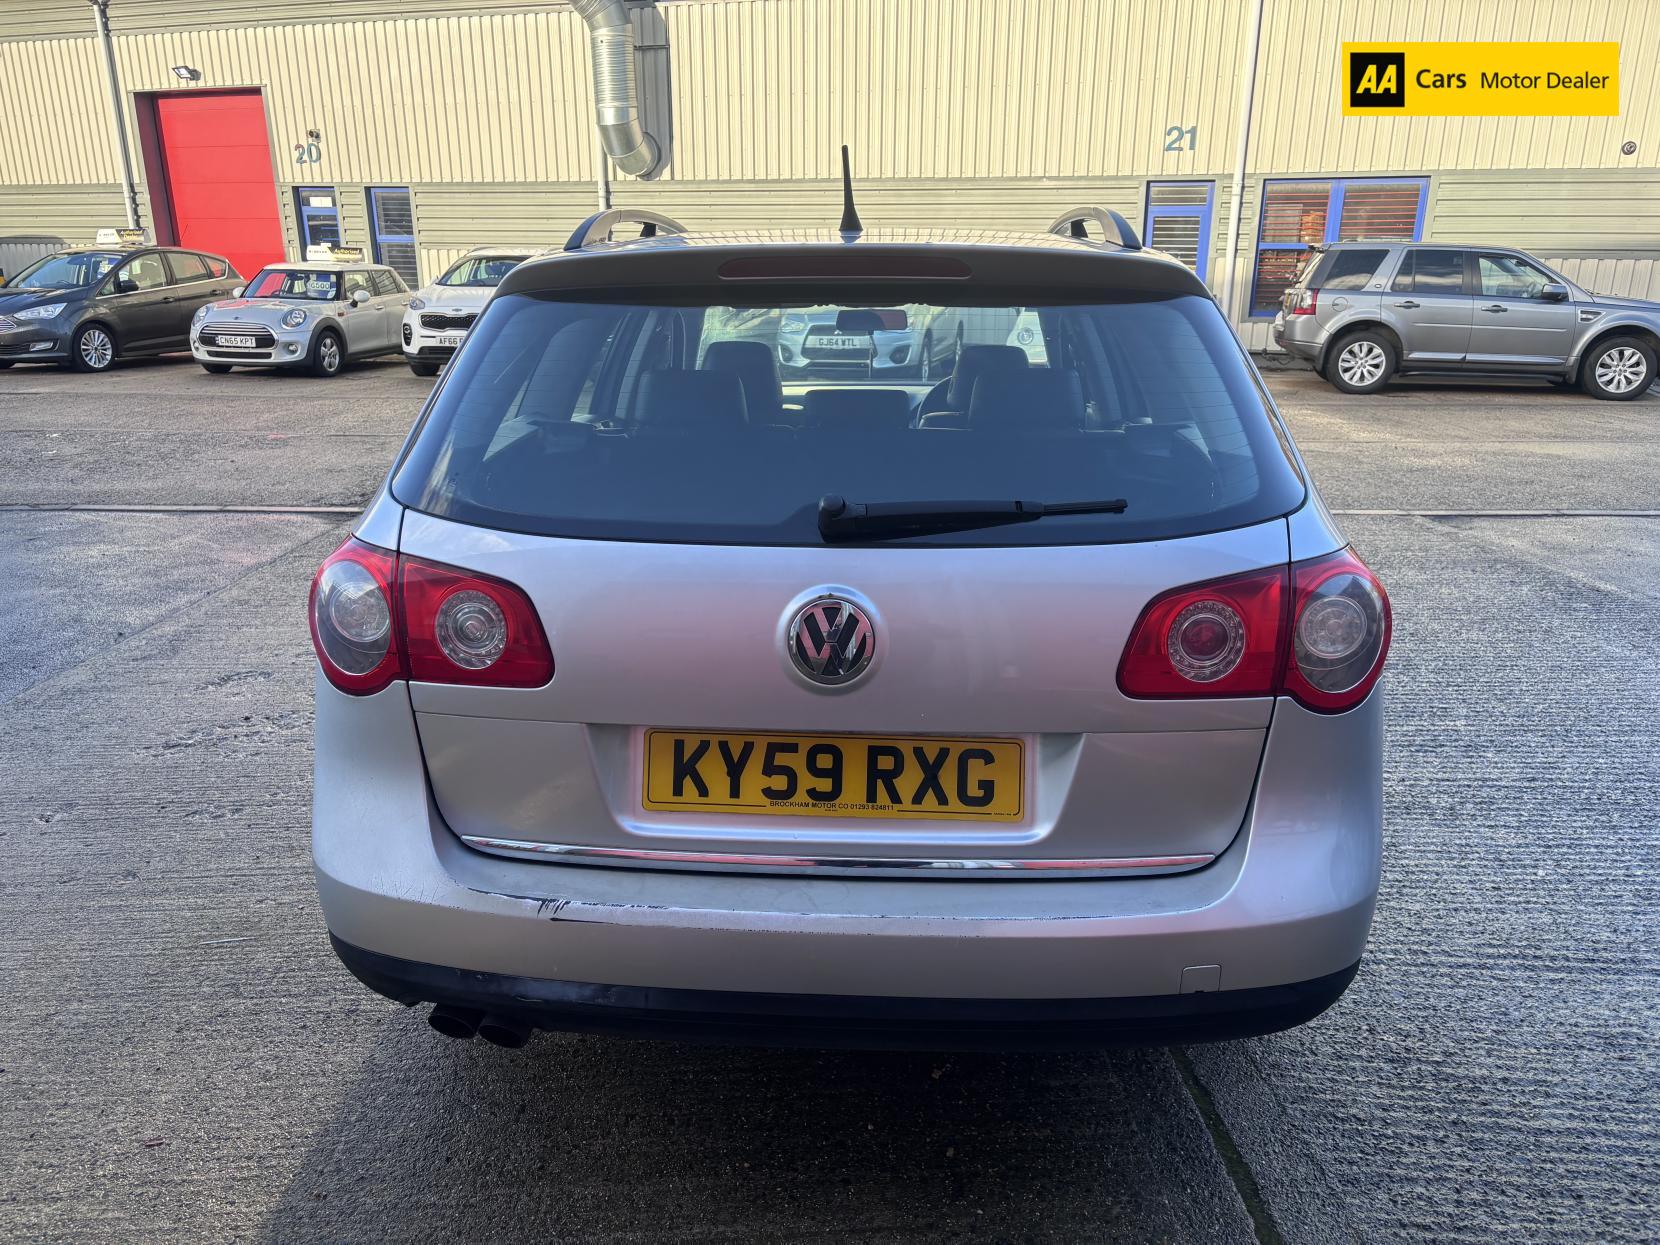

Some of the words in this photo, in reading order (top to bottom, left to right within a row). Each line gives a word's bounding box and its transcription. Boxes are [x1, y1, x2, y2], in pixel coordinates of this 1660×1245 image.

[1166, 126, 1197, 151] 21
[294, 143, 321, 164] 20
[220, 336, 239, 345] CN65
[439, 337, 458, 345] AF66
[671, 738, 844, 801] KY59
[866, 744, 997, 808] RXG
[769, 800, 810, 809] BROCKHAM
[850, 803, 870, 811] 01293
